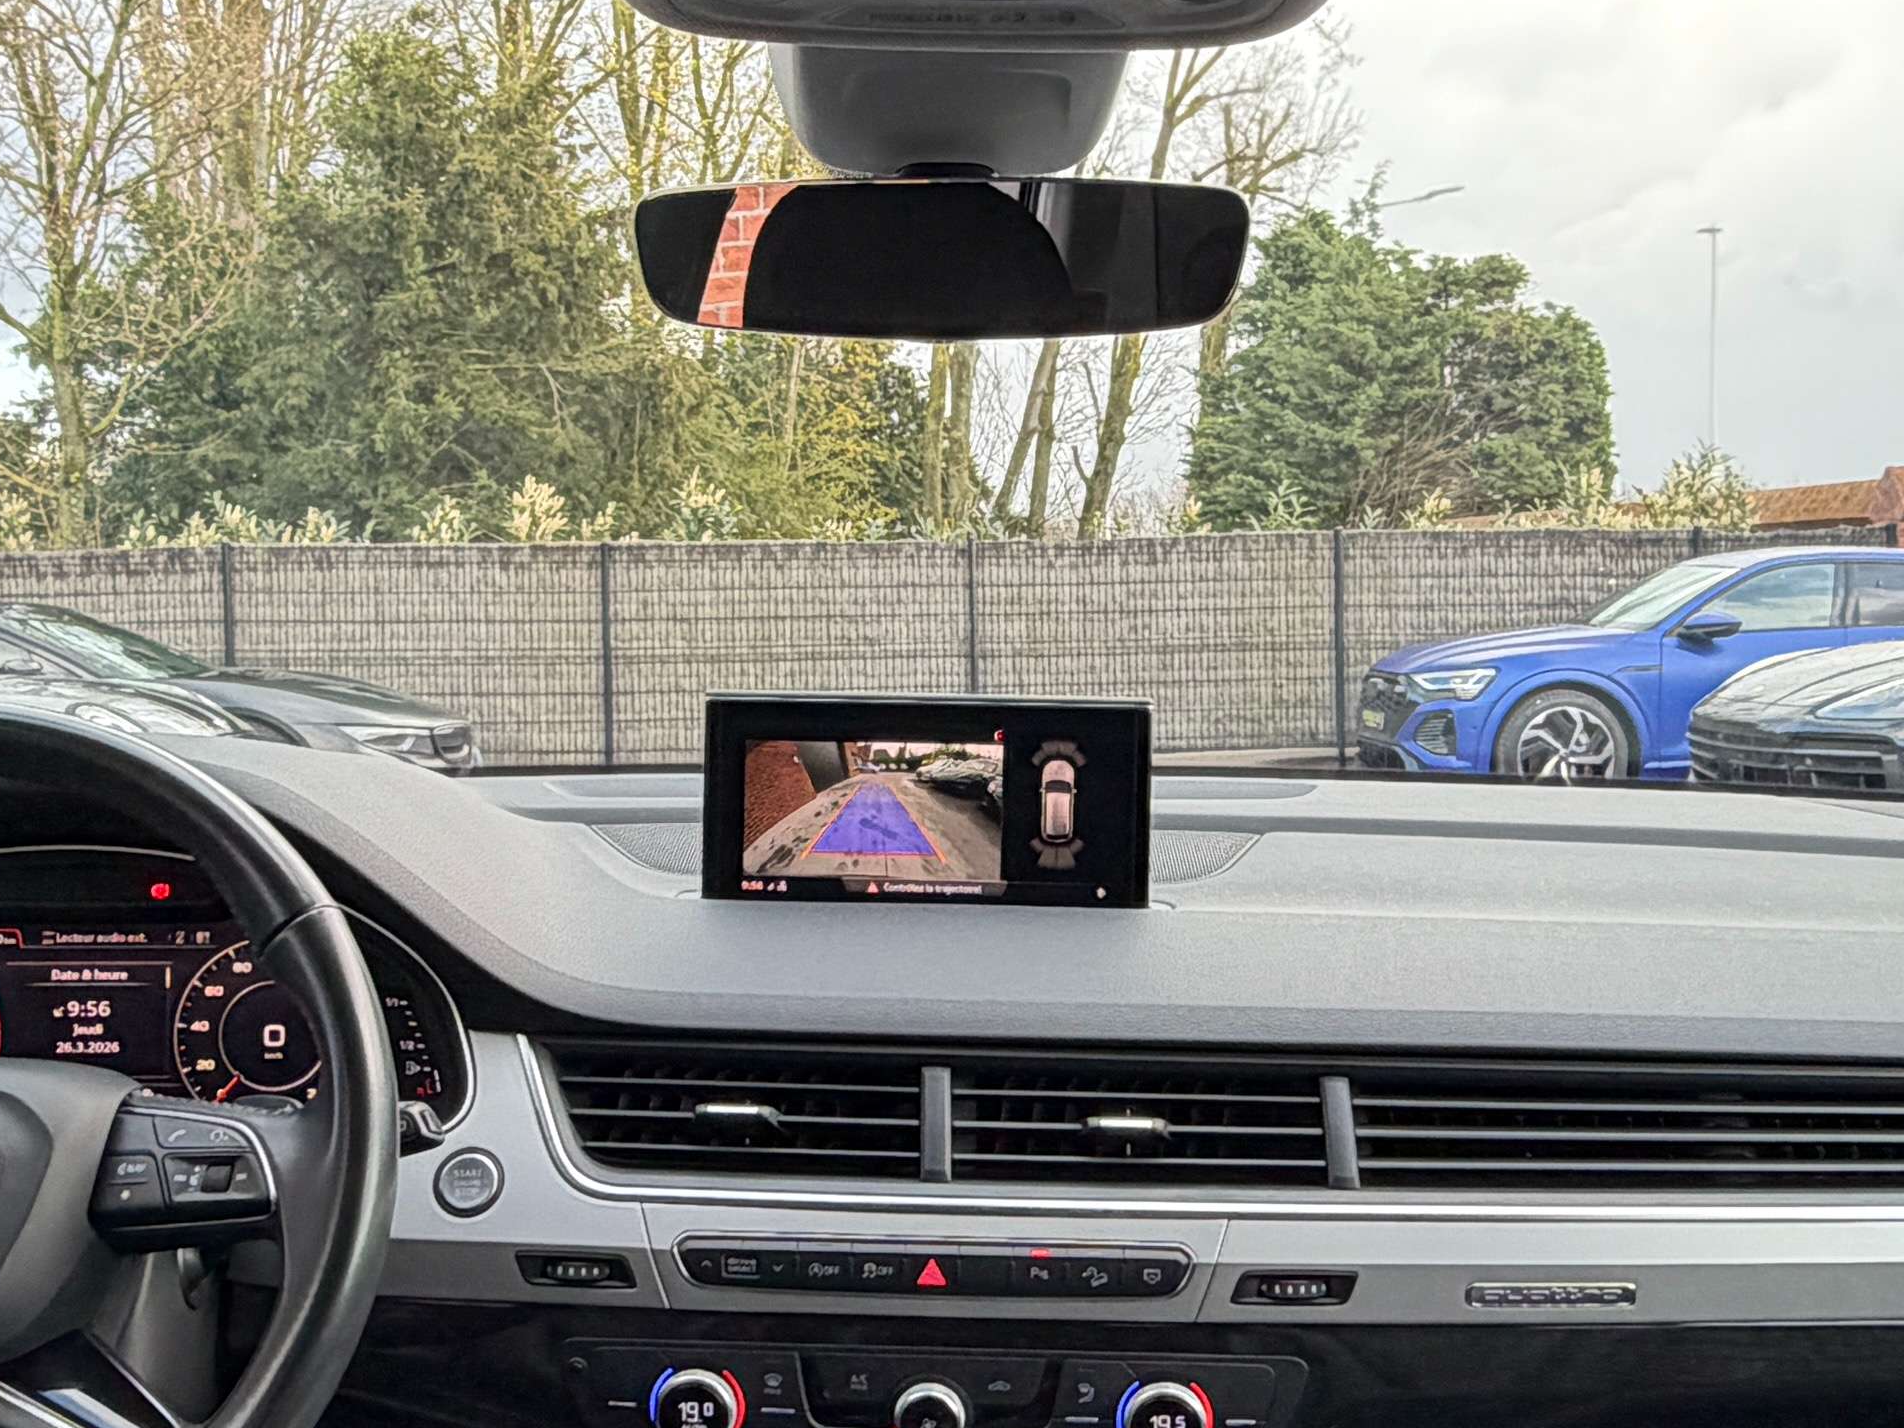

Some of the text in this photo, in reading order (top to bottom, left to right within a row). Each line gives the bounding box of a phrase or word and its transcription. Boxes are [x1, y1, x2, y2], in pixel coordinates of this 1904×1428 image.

[67, 1000, 111, 1018] 9:56
[263, 1024, 286, 1047] 0
[55, 1041, 121, 1054] 26.3.2026
